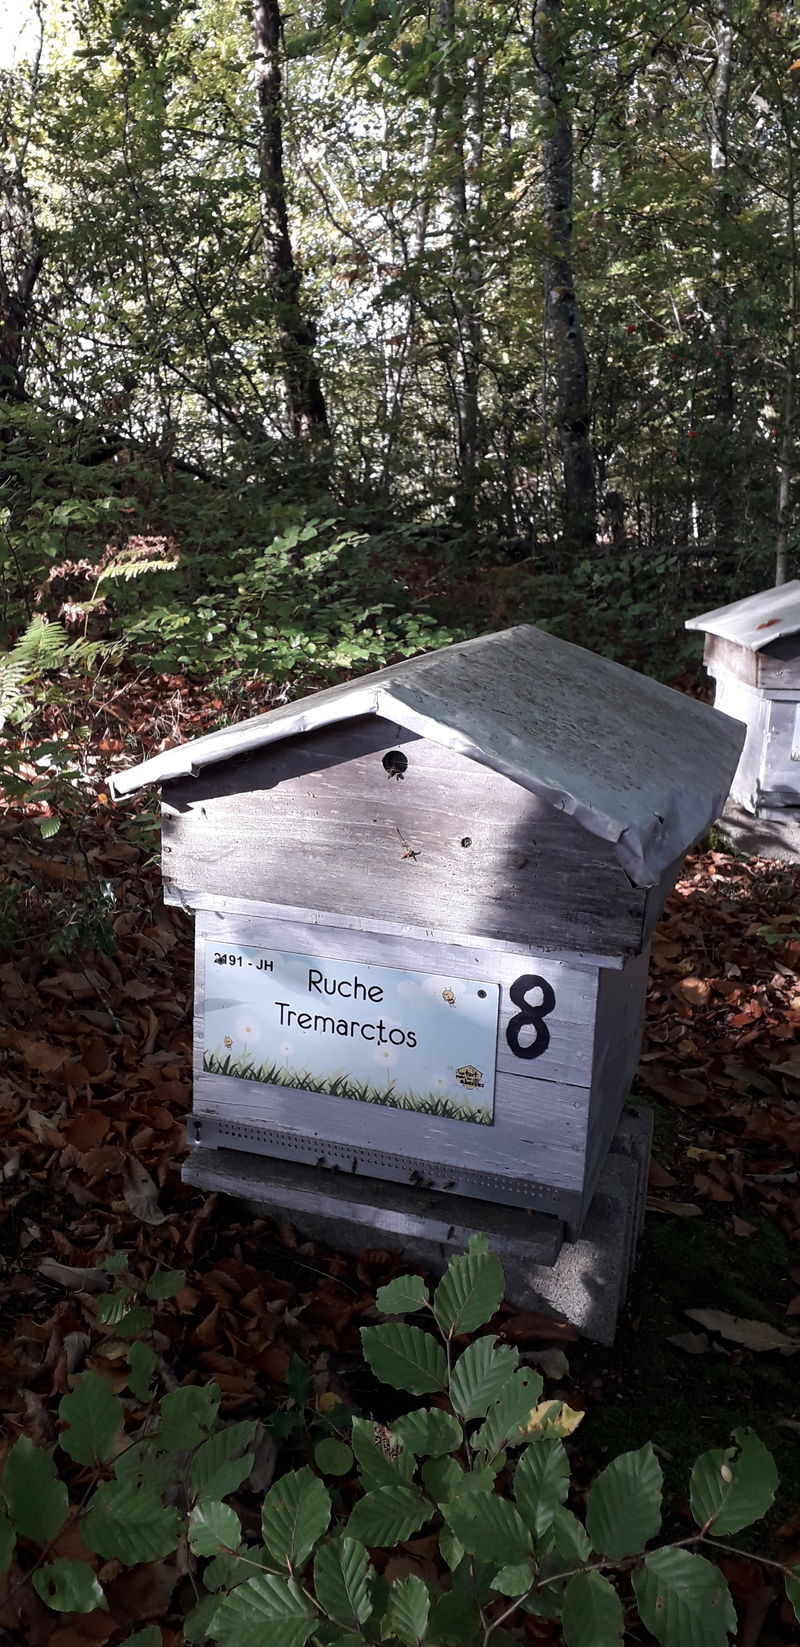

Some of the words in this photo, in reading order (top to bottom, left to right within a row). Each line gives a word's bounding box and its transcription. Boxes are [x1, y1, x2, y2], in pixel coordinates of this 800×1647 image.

[214, 952, 243, 967] 2191
[256, 959, 274, 972] JH
[308, 968, 385, 1003] Ruche
[274, 1001, 418, 1048] Tremarctos
[506, 974, 556, 1060] 8
